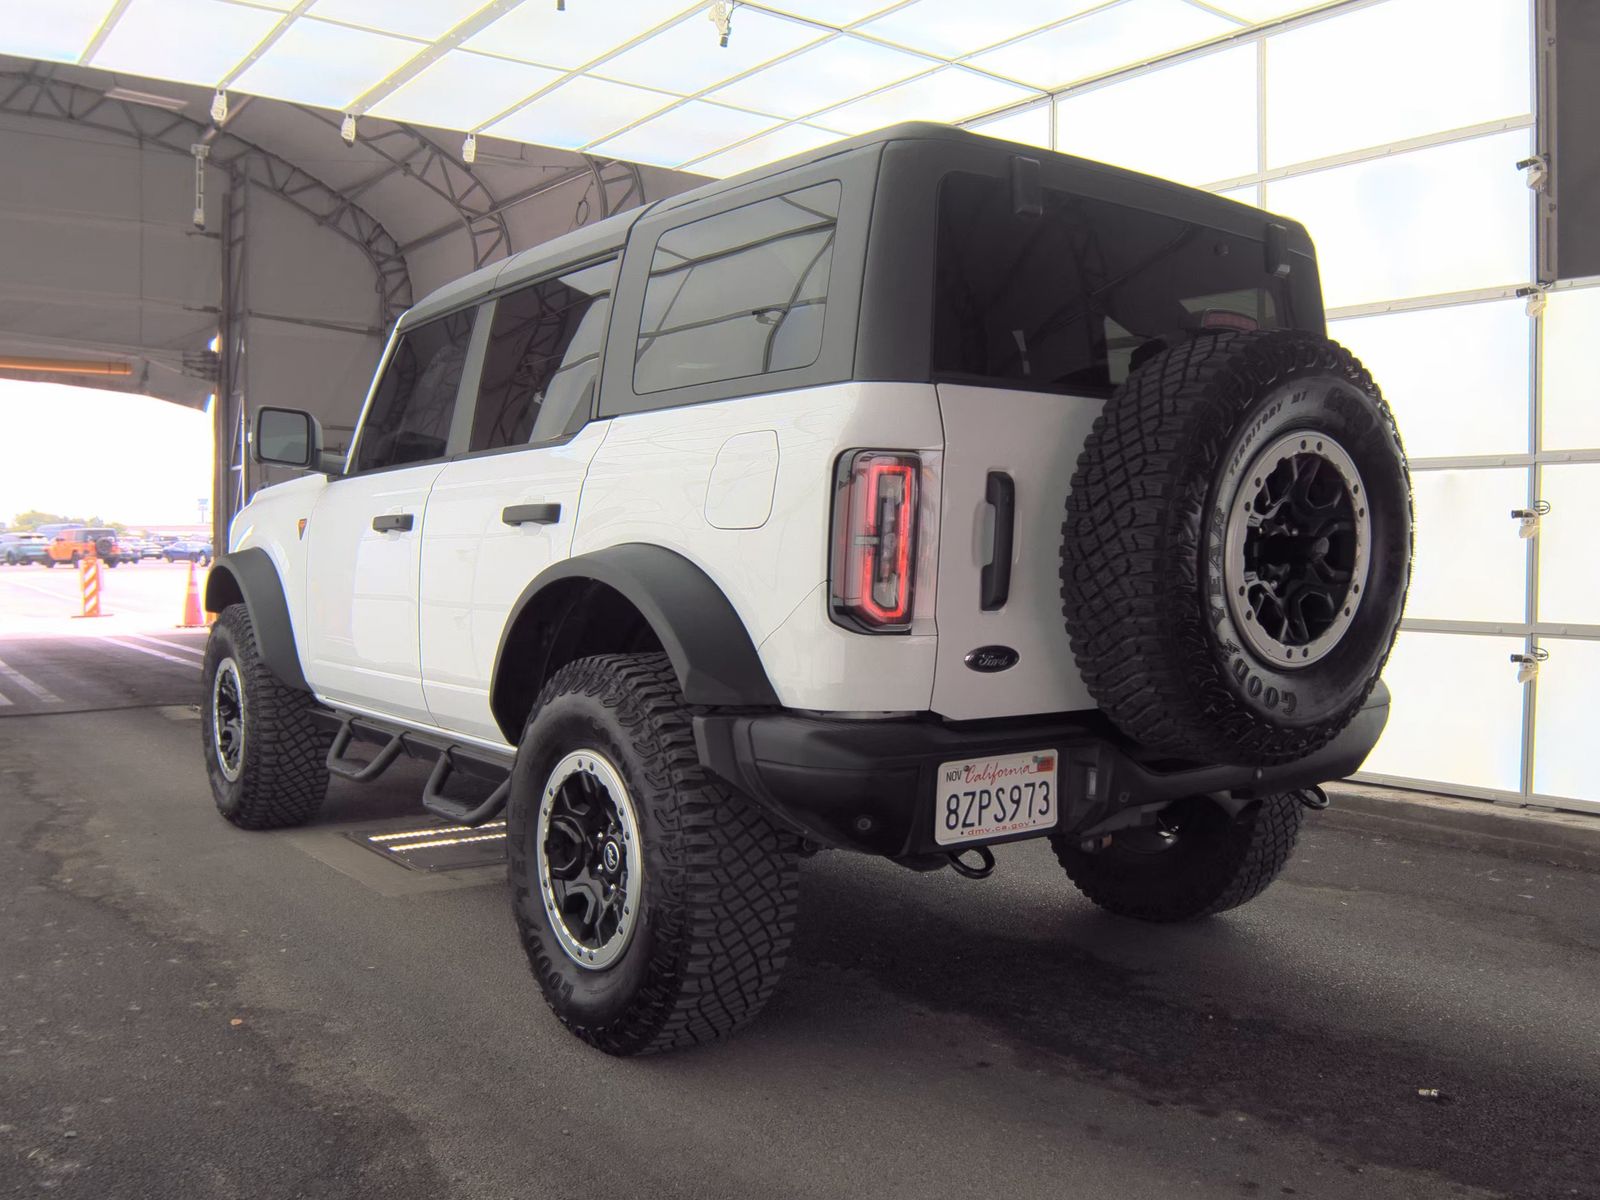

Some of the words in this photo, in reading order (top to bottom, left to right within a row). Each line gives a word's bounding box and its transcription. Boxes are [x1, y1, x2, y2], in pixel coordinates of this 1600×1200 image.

[1228, 400, 1284, 476] TERRITORY
[978, 653, 1009, 667] Ford
[945, 769, 962, 783] NOV
[964, 760, 1039, 785] California
[945, 780, 1050, 831] 8ZPS973
[967, 820, 1031, 837] dmv.ca.gov
